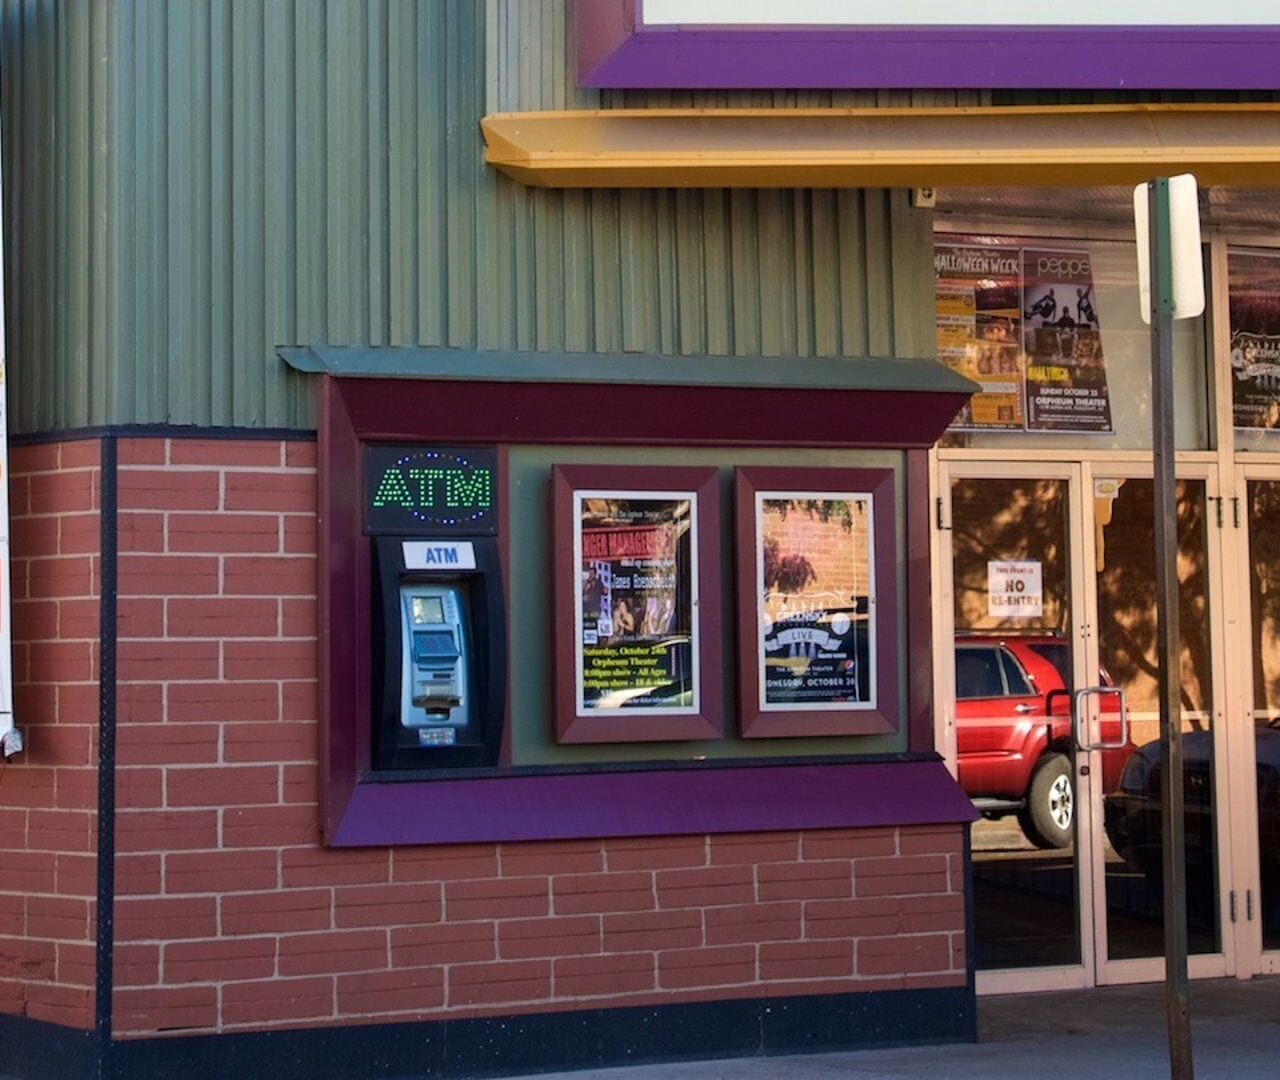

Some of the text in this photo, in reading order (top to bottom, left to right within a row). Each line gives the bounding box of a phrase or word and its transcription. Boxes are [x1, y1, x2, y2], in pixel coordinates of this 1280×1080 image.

[934, 254, 1020, 275] HALLOWEEN WEEK
[1040, 387, 1063, 396] SUNDAY
[1063, 388, 1090, 397] OCTOBER
[1035, 396, 1107, 407] ORPHEUM THEATER
[373, 468, 491, 507] ATM
[425, 547, 459, 564] ATM
[1005, 579, 1026, 593] NO
[991, 595, 1040, 606] RE-ENTRY
[791, 631, 813, 640] LIVE
[583, 647, 619, 658] Saturday,
[619, 647, 650, 656] October
[592, 657, 659, 668] Orpheum Theater
[806, 677, 844, 687] OCTOBER
